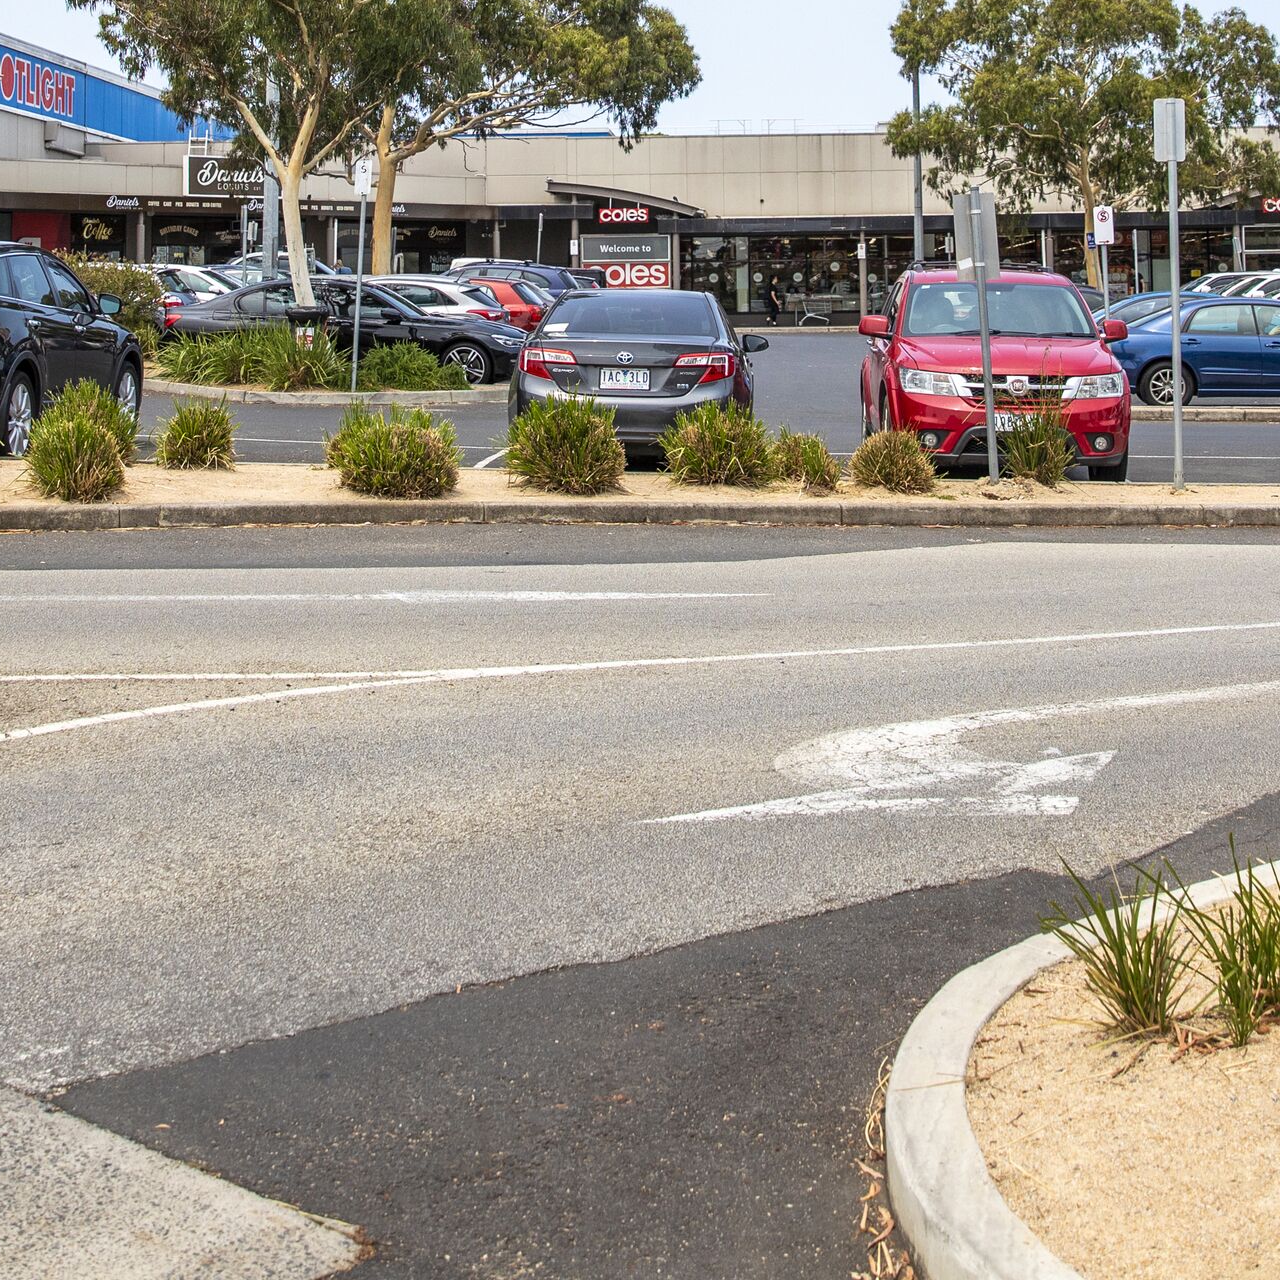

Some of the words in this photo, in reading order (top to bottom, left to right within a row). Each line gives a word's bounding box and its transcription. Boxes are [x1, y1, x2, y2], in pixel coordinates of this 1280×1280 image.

[599, 207, 648, 223] coles
[600, 244, 639, 253] Welcome
[641, 244, 651, 253] to
